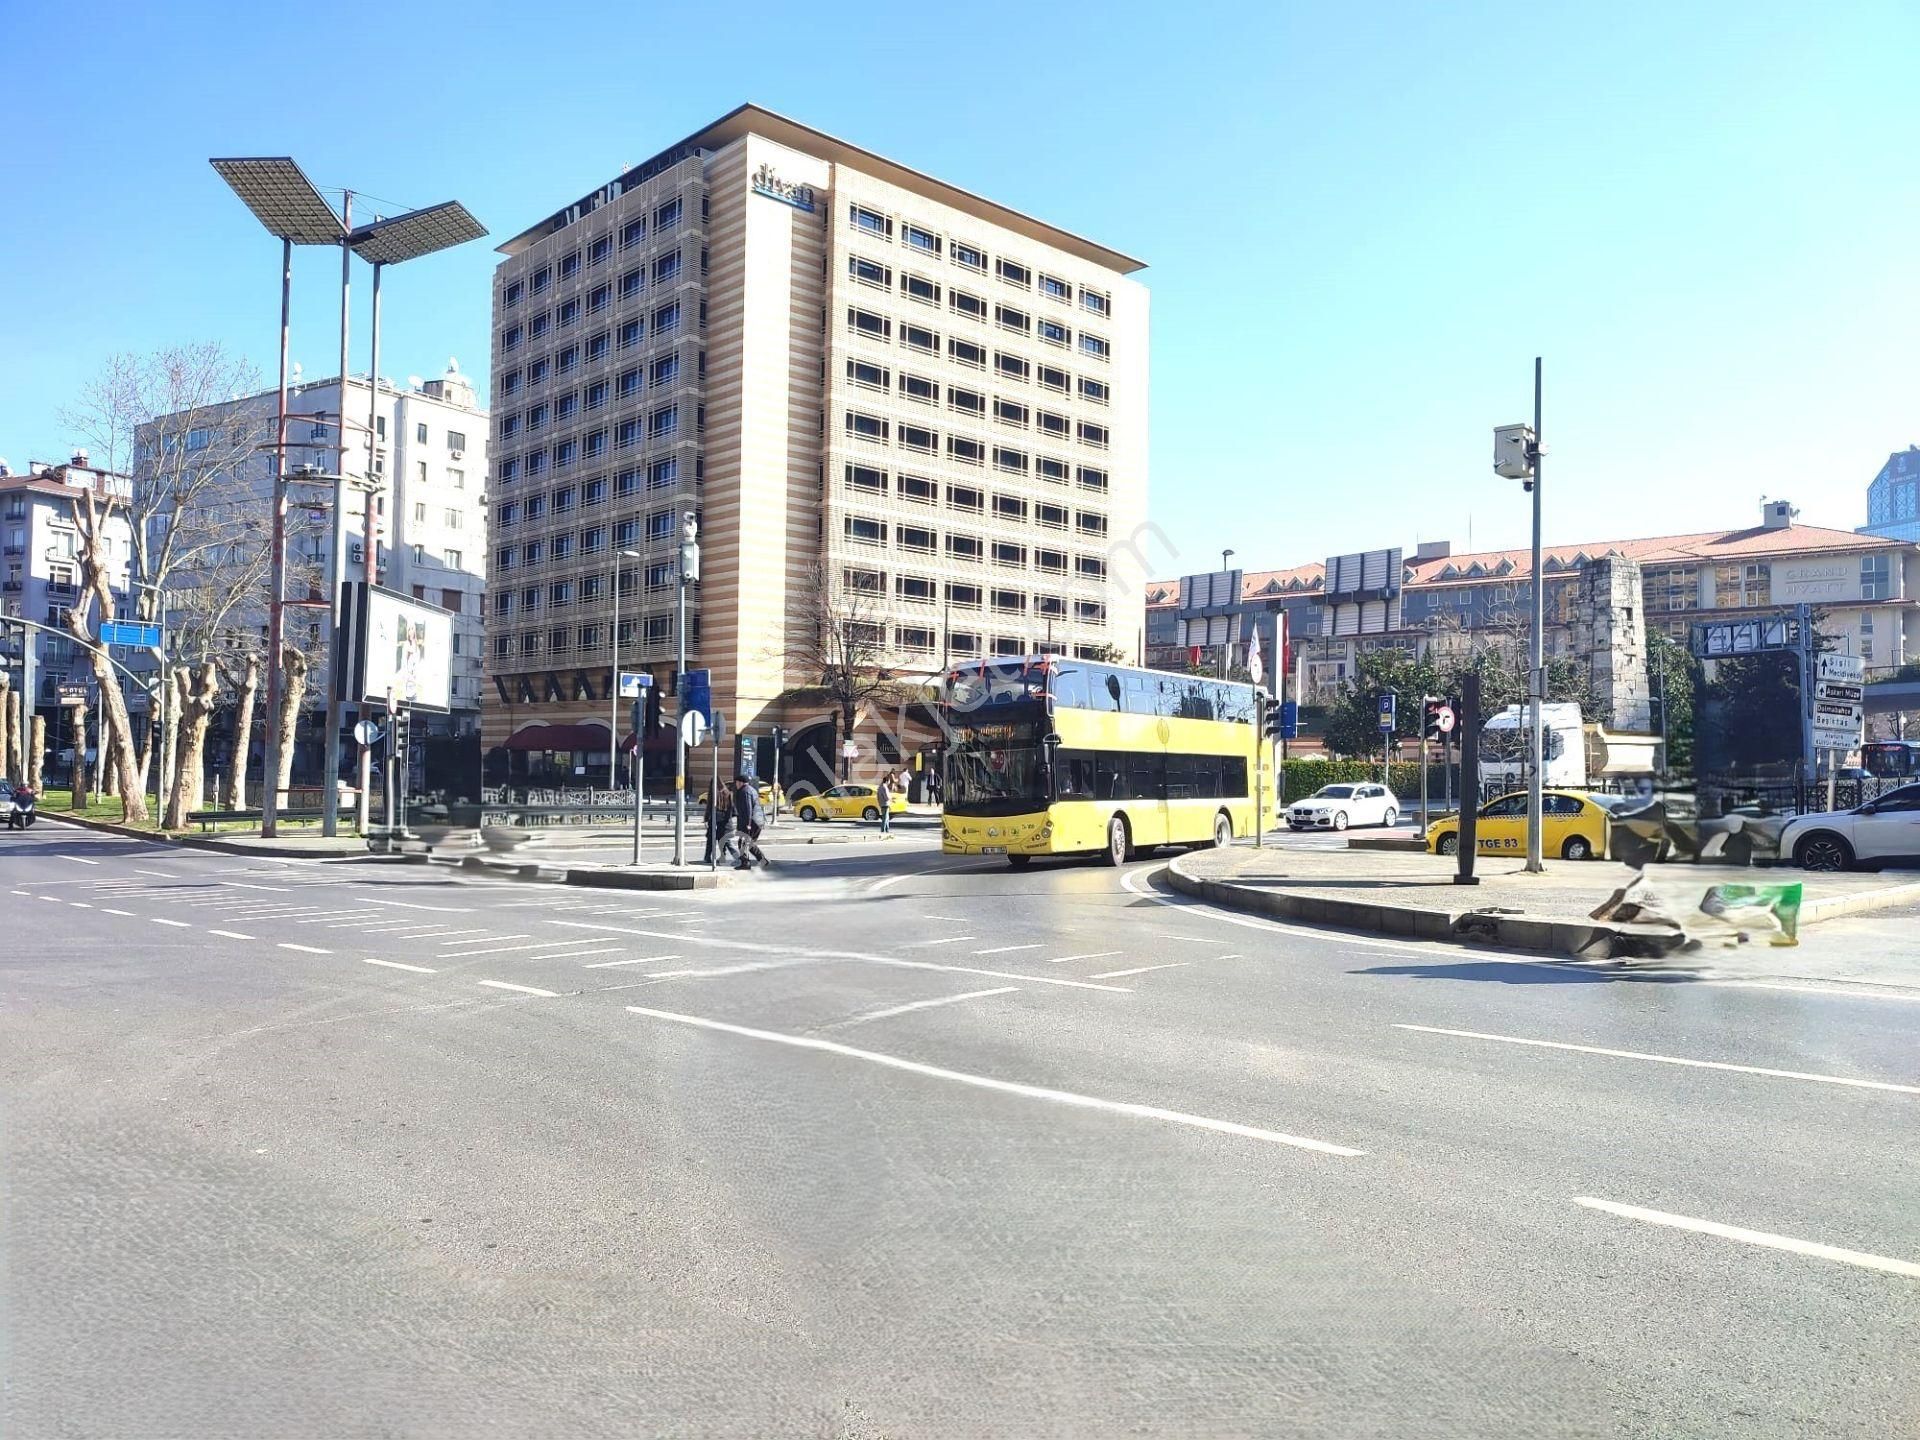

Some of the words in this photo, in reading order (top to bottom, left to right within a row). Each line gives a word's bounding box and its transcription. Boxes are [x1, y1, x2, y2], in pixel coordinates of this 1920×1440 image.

[1785, 568, 1848, 580] GRAND
[1478, 839, 1501, 848] TGE
[1504, 838, 1518, 848] 83
